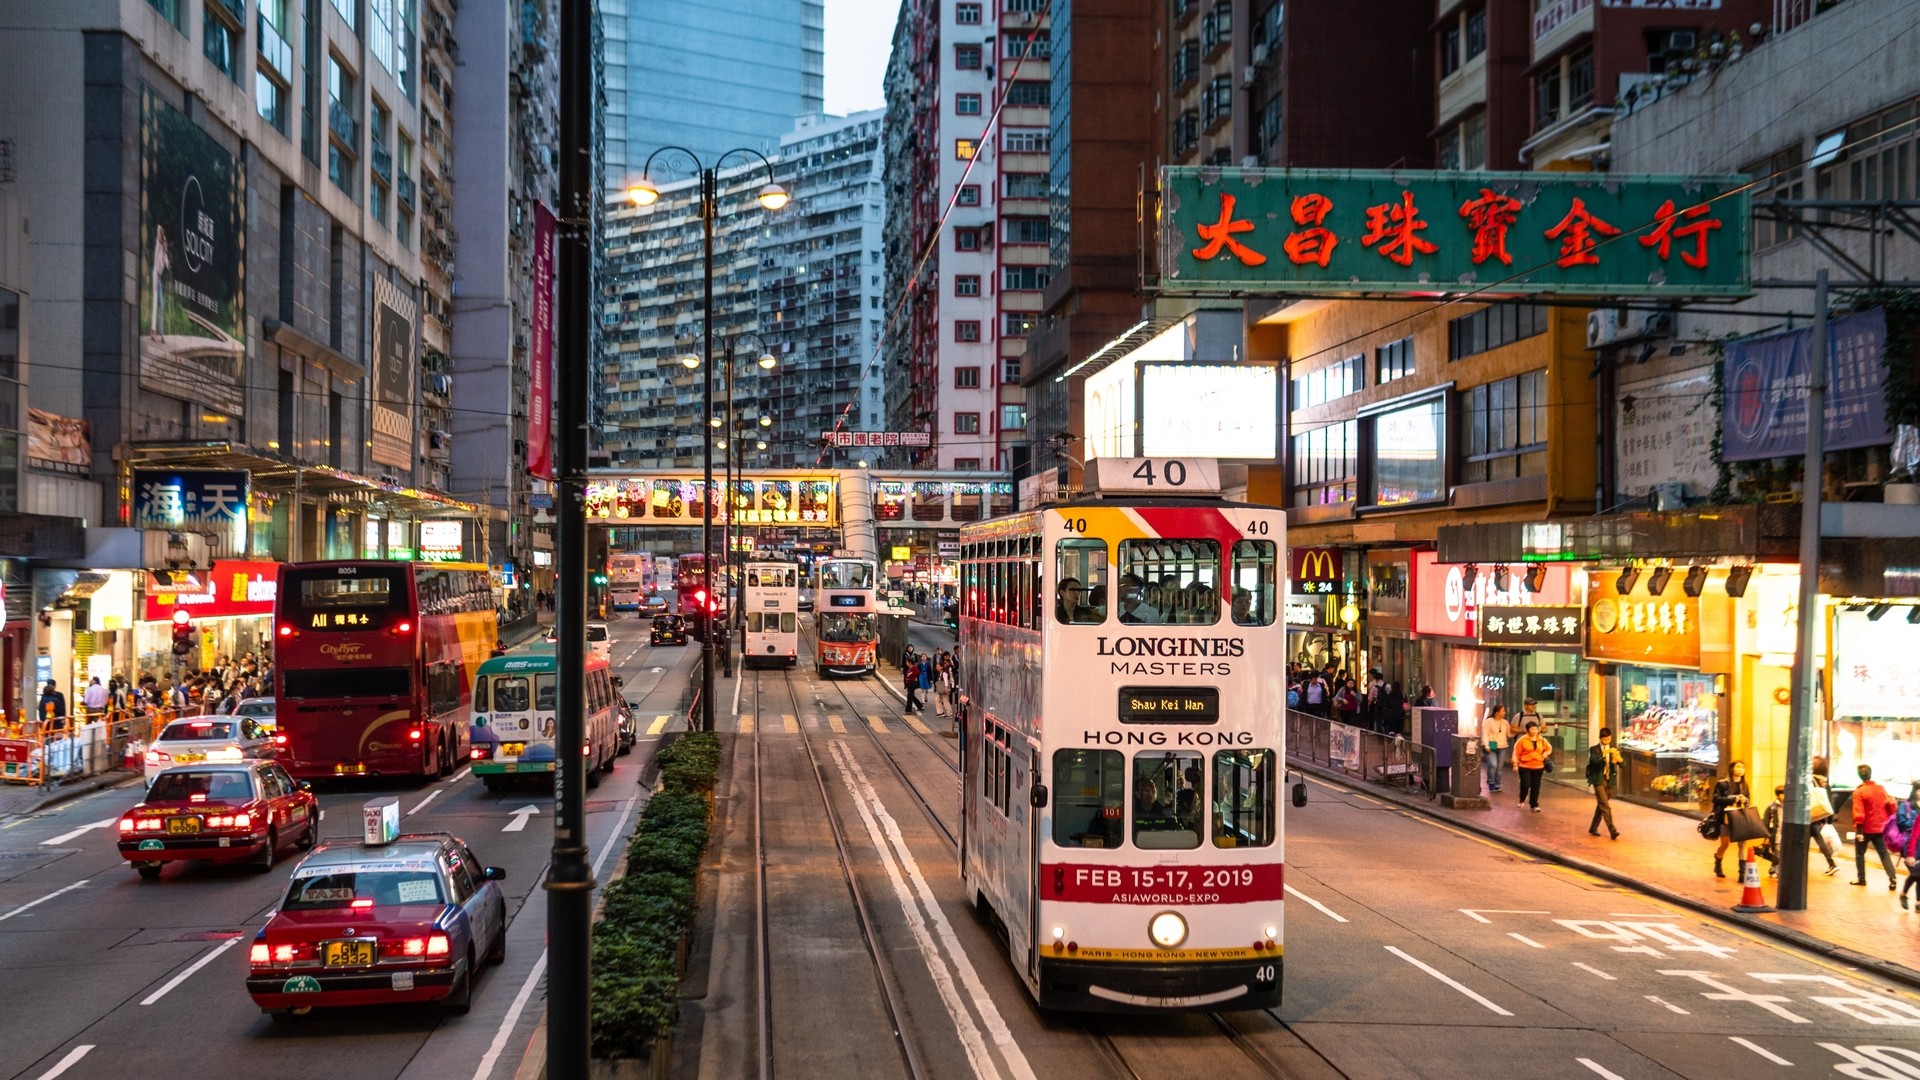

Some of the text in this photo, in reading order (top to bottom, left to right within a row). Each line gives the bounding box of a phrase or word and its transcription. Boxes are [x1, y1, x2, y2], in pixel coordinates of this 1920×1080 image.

[1193, 188, 1723, 270] 大昌珠寶金行
[1132, 459, 1187, 487] 40
[1064, 517, 1087, 533] 40
[1247, 520, 1269, 535] 40
[337, 567, 357, 575] 8054
[1318, 582, 1333, 593] 24
[1618, 598, 1688, 635] 新世界珠寶
[1486, 615, 1578, 636] 新世界珠寶
[1097, 637, 1244, 658] LONGINES
[1111, 662, 1231, 675] MASTERS
[1131, 699, 1205, 710] Shau Kei Wan
[1084, 731, 1254, 746] HONG KONG
[1104, 808, 1121, 817] 101
[173, 825, 197, 833] 9908
[367, 818, 378, 834] 的士
[1076, 869, 1254, 890] FEB 15-17, 2019
[305, 888, 349, 899] TAXI
[1112, 892, 1220, 903] ASIAWORLD-EXPO
[340, 943, 359, 955] GM
[1122, 950, 1152, 958] HONG
[331, 953, 369, 965] 2932
[1256, 965, 1275, 981] 40
[297, 980, 306, 988] 4
